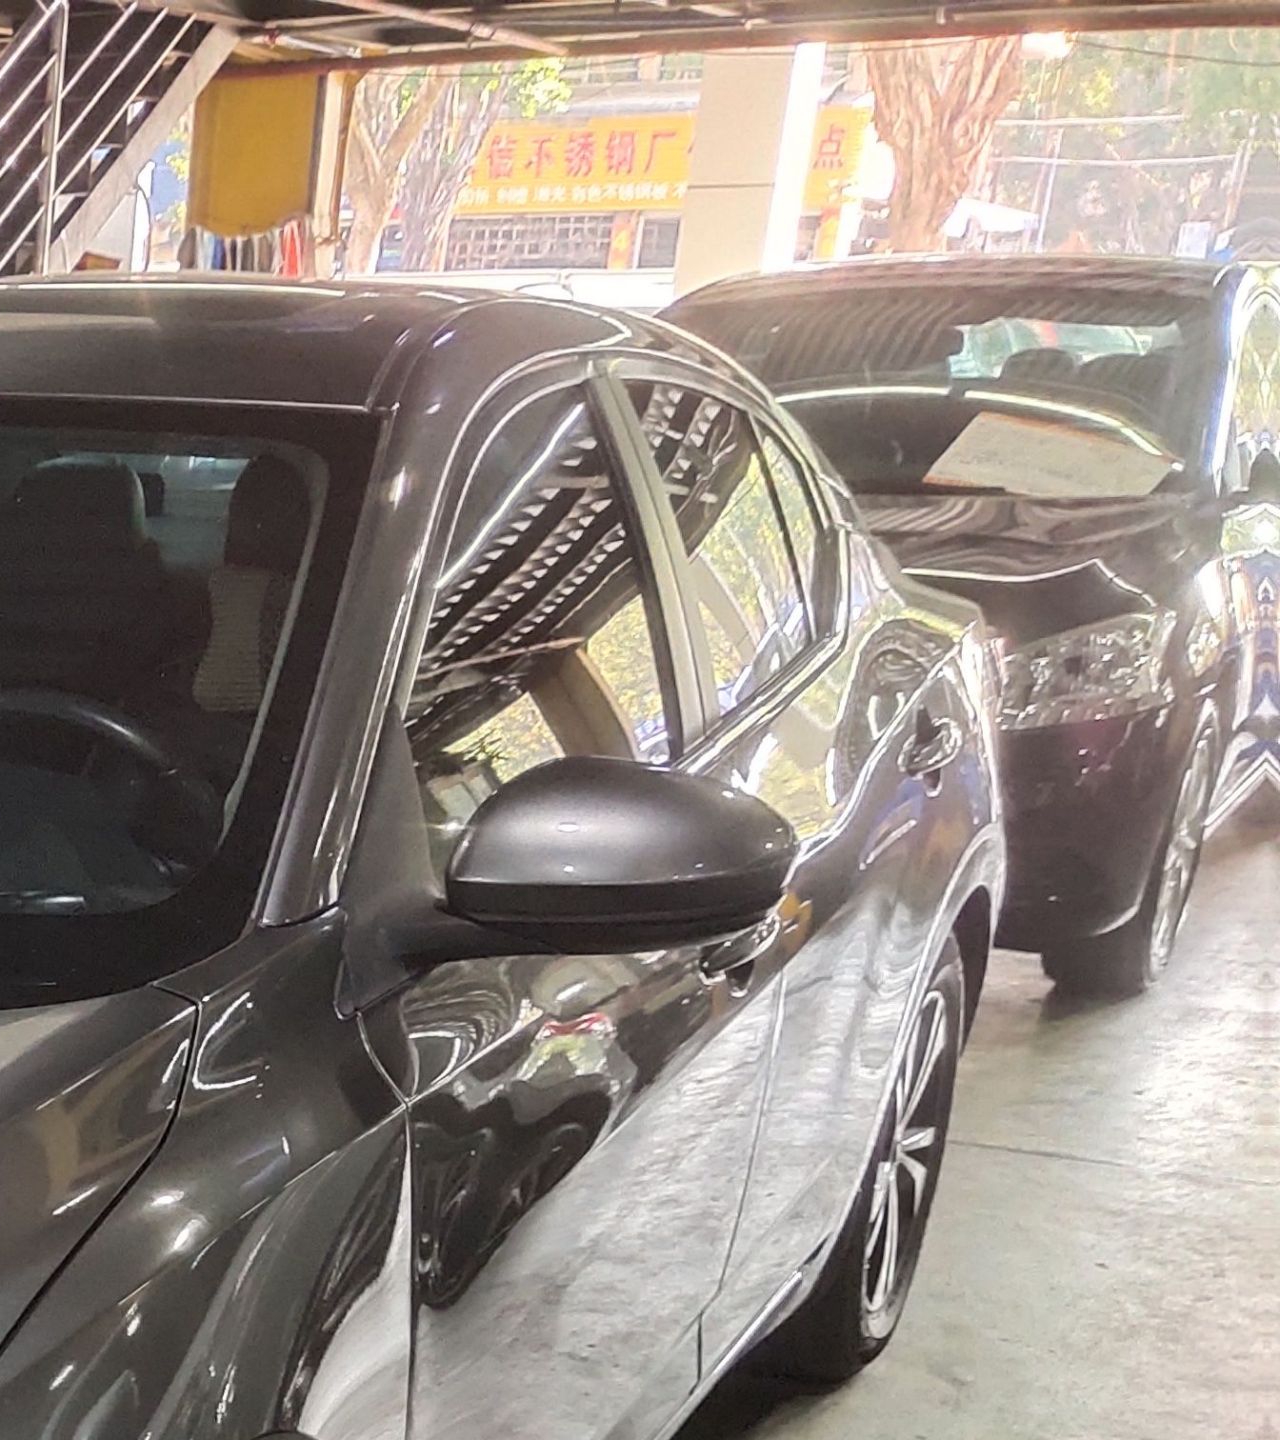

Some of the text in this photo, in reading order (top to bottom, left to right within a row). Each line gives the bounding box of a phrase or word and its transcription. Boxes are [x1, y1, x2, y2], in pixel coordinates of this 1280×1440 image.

[469, 130, 696, 179] 信不锈钢厂
